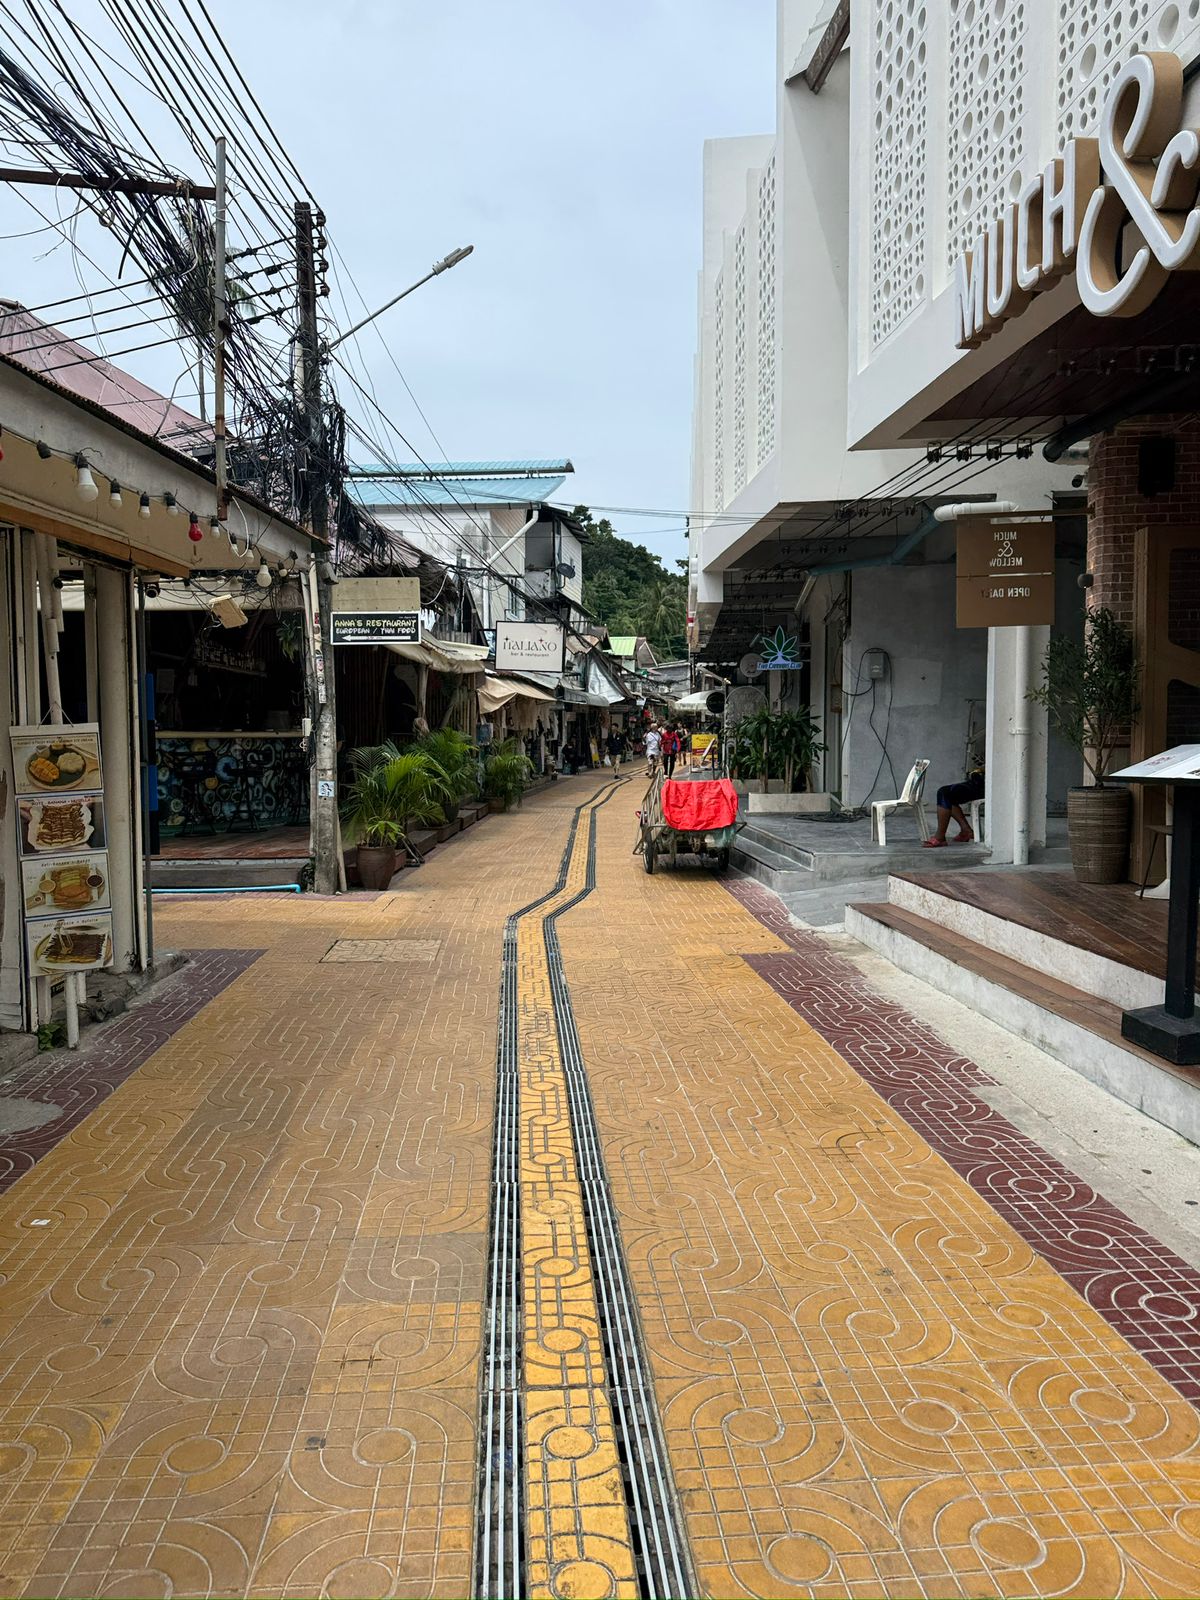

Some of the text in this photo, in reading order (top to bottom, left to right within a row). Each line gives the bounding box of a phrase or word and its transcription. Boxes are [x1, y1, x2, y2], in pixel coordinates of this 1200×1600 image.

[955, 51, 1200, 350] MUCH &
[334, 619, 417, 627] ANNA'S RESTAURANT
